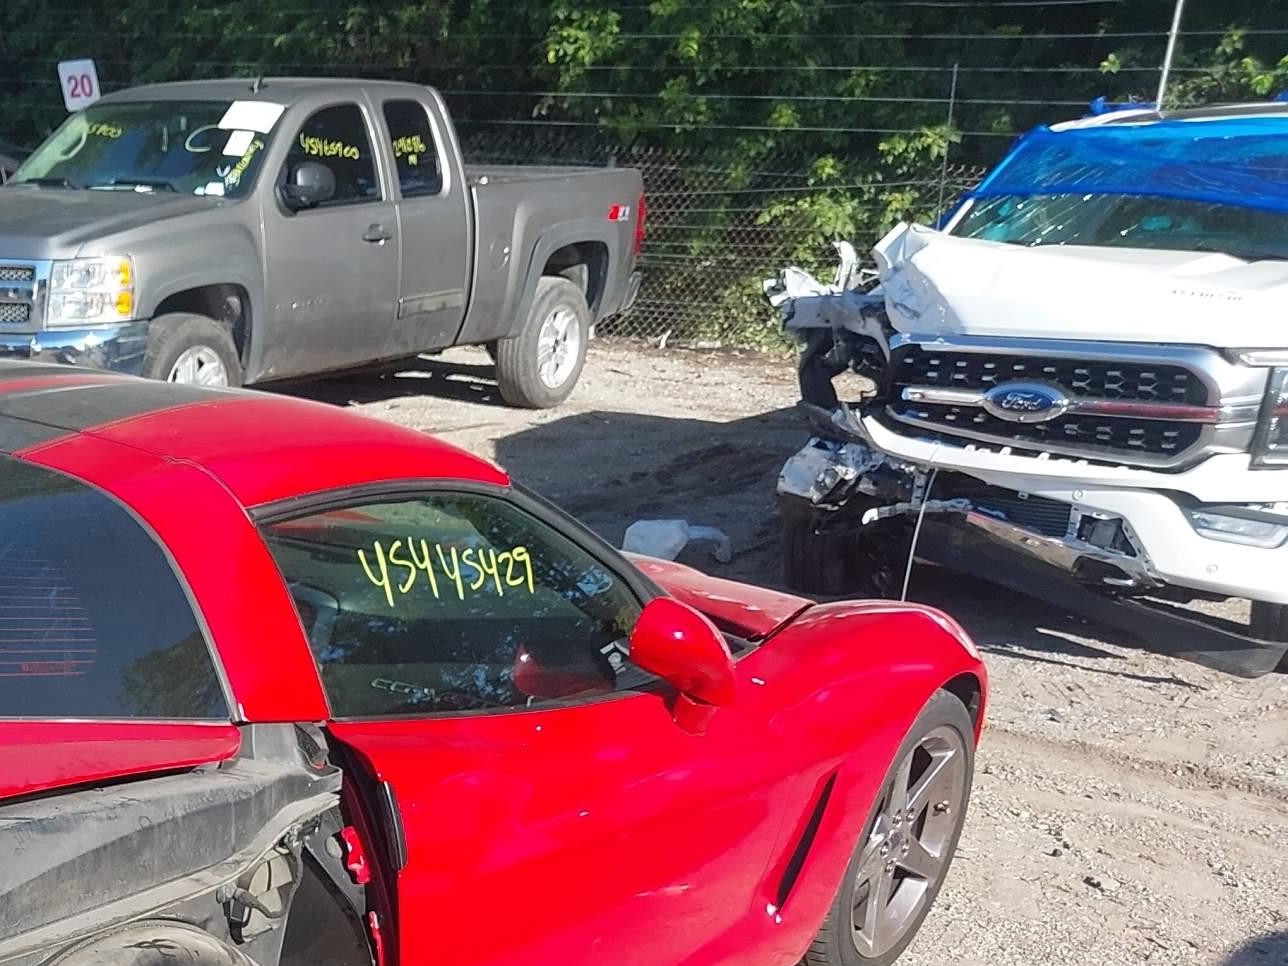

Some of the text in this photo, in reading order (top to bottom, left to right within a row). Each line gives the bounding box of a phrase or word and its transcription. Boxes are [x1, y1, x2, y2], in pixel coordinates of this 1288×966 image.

[66, 74, 93, 98] 20
[1001, 391, 1043, 410] Ford
[357, 536, 535, 607] 45445429
